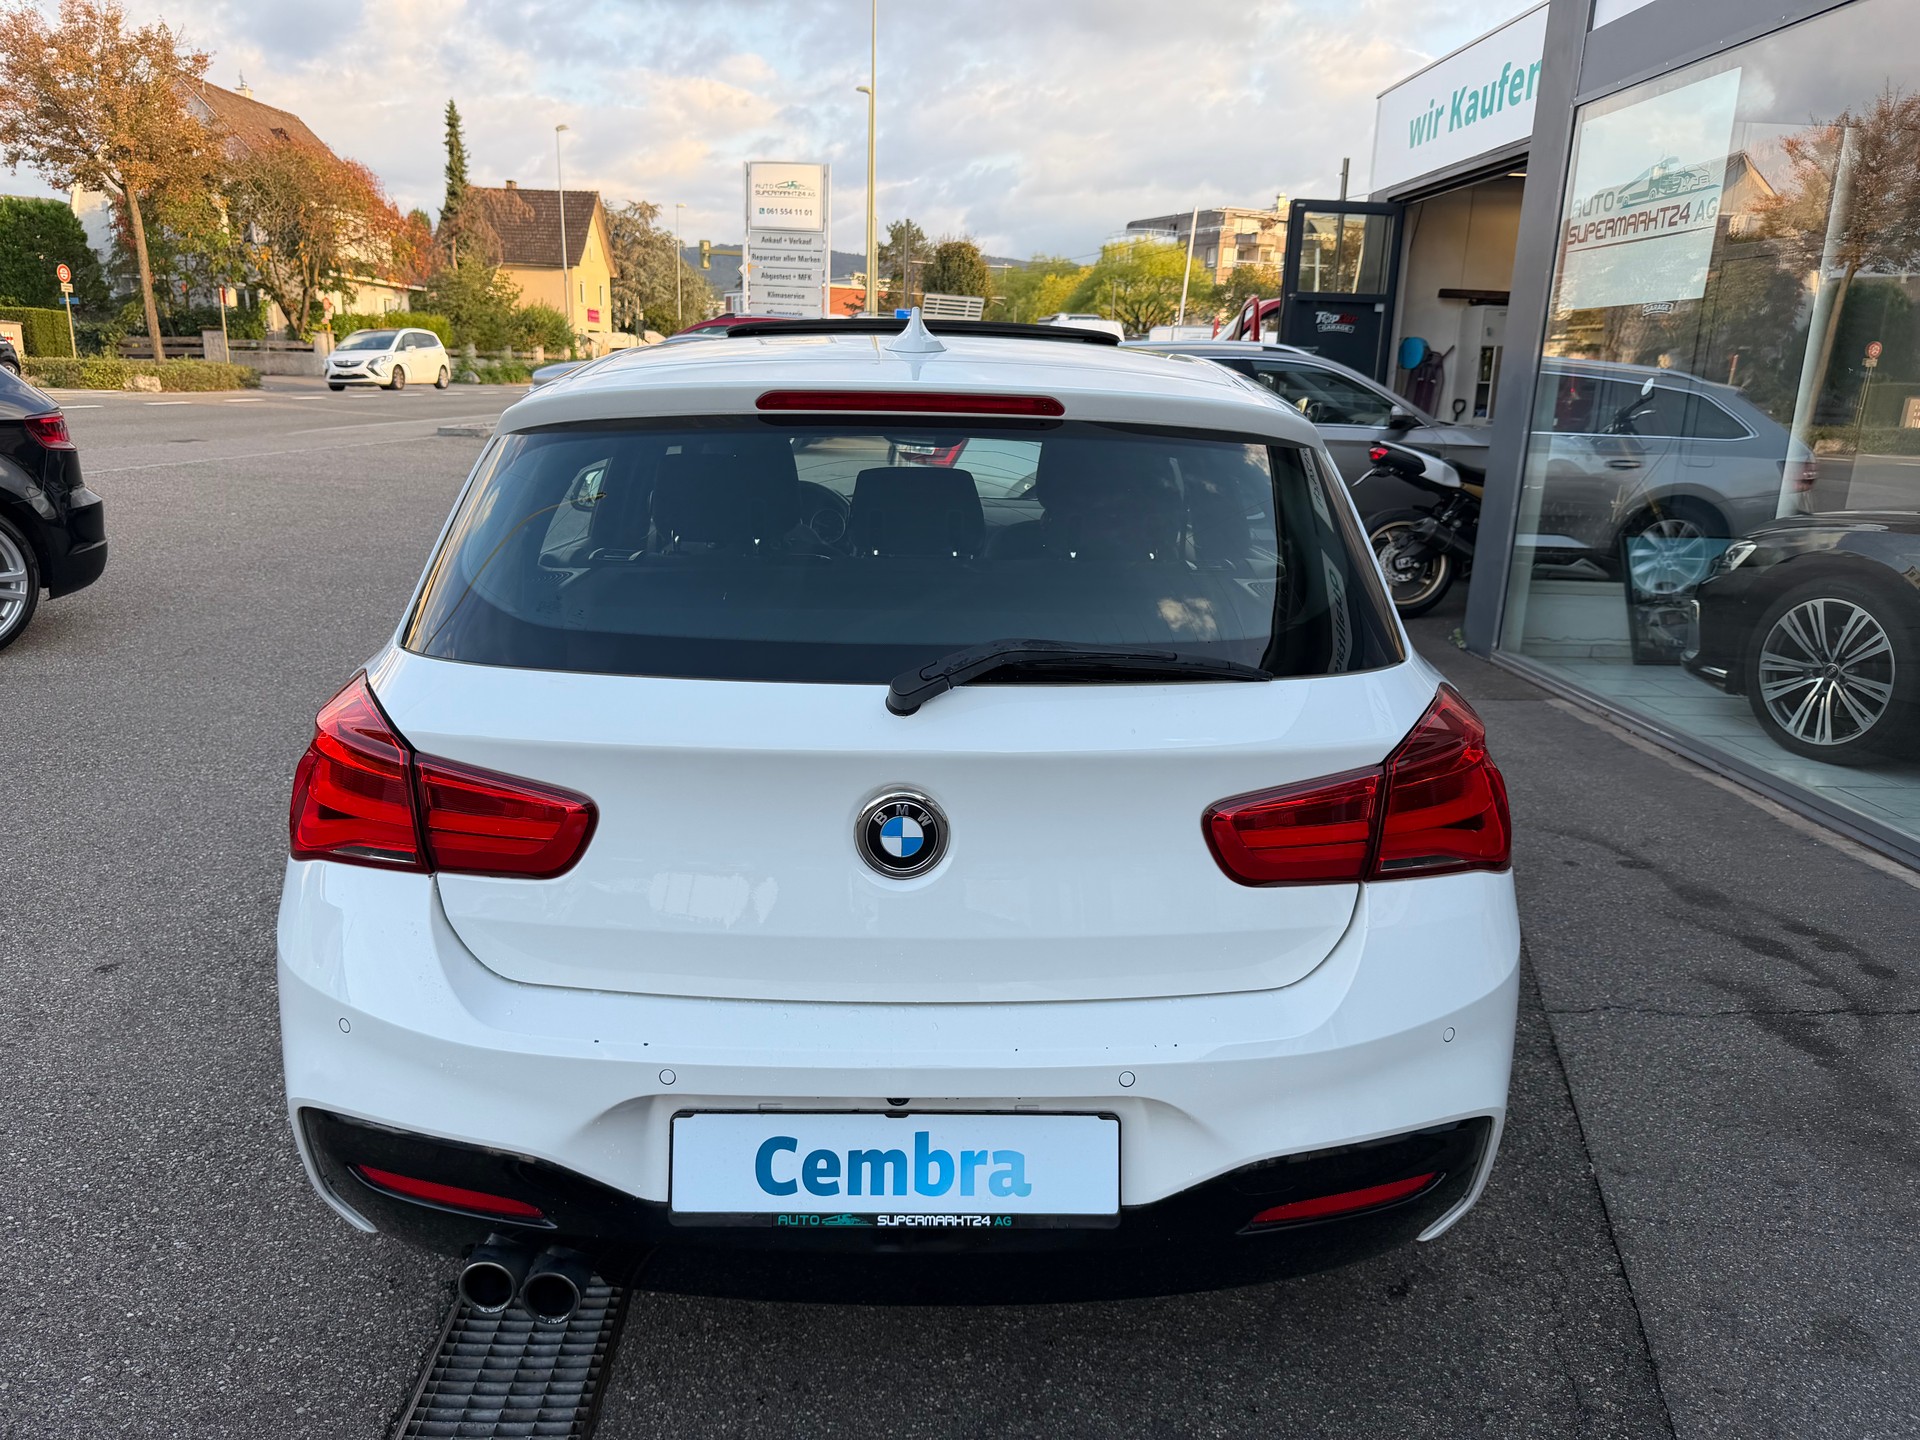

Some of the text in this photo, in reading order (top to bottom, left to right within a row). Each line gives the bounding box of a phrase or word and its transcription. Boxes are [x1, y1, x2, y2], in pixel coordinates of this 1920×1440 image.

[1410, 98, 1445, 150] wir
[1570, 191, 1615, 220] AUTO
[1567, 197, 1718, 246] SUPERMARKT24 AG
[761, 236, 783, 244] Ankauf
[752, 253, 782, 262] Reparatur
[767, 291, 805, 299] Klimaservice
[873, 804, 932, 827] BMW
[755, 1131, 1032, 1197] Cembra
[778, 1215, 1012, 1226] AUTO SUPERMARKT24 AG
